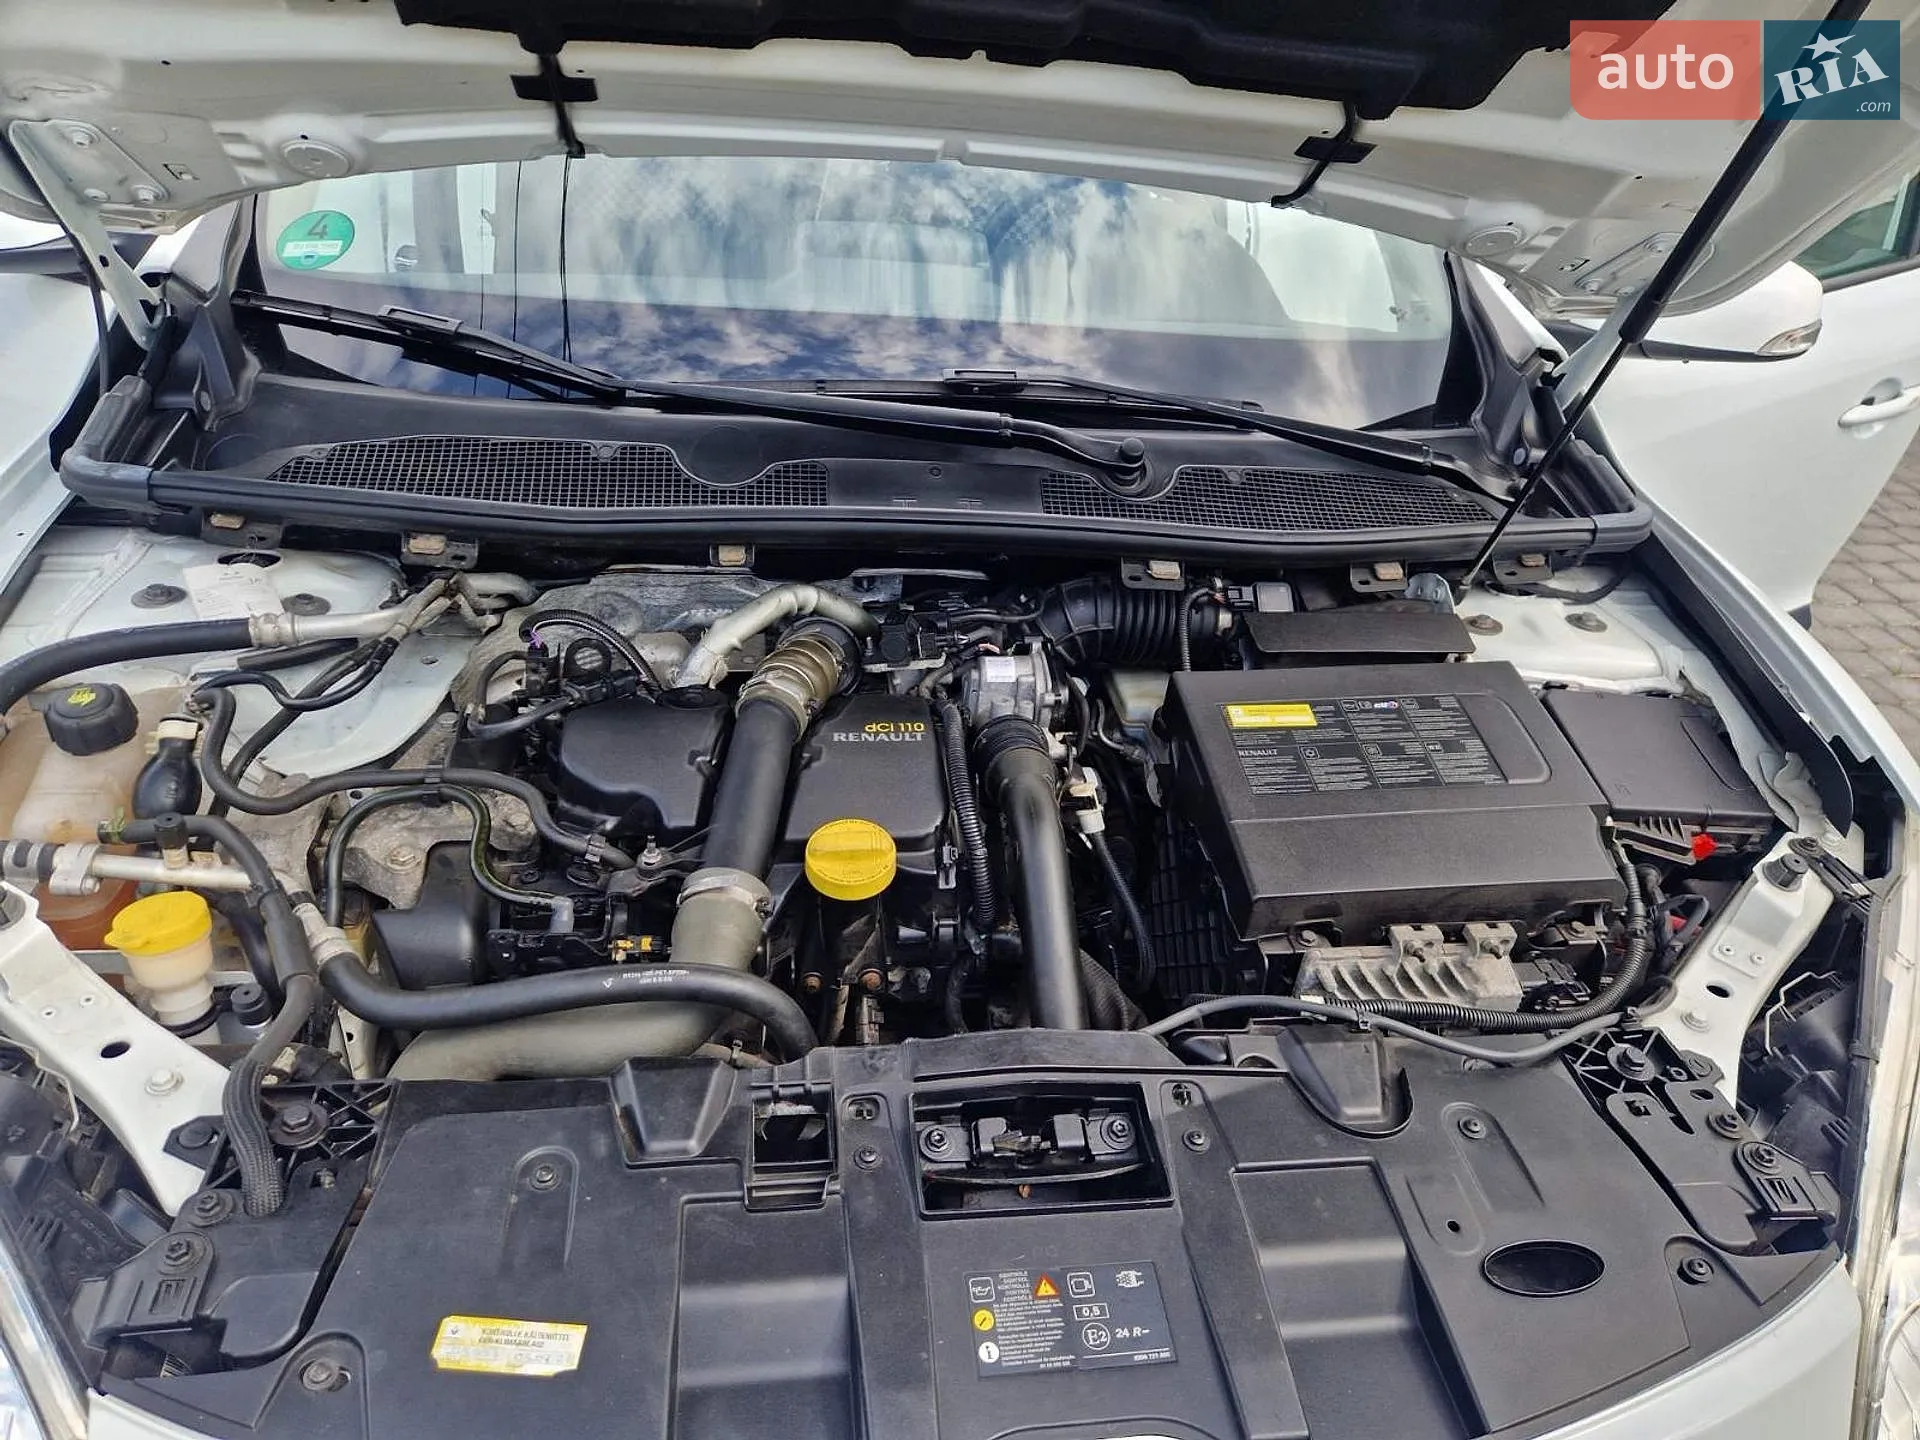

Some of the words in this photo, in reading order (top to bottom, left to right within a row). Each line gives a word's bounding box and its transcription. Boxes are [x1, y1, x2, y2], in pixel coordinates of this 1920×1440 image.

[307, 213, 331, 240] 4
[899, 722, 925, 732] 110
[832, 731, 925, 742] RENAULT
[1238, 748, 1278, 757] RENAULT
[1115, 1328, 1130, 1338] 24
